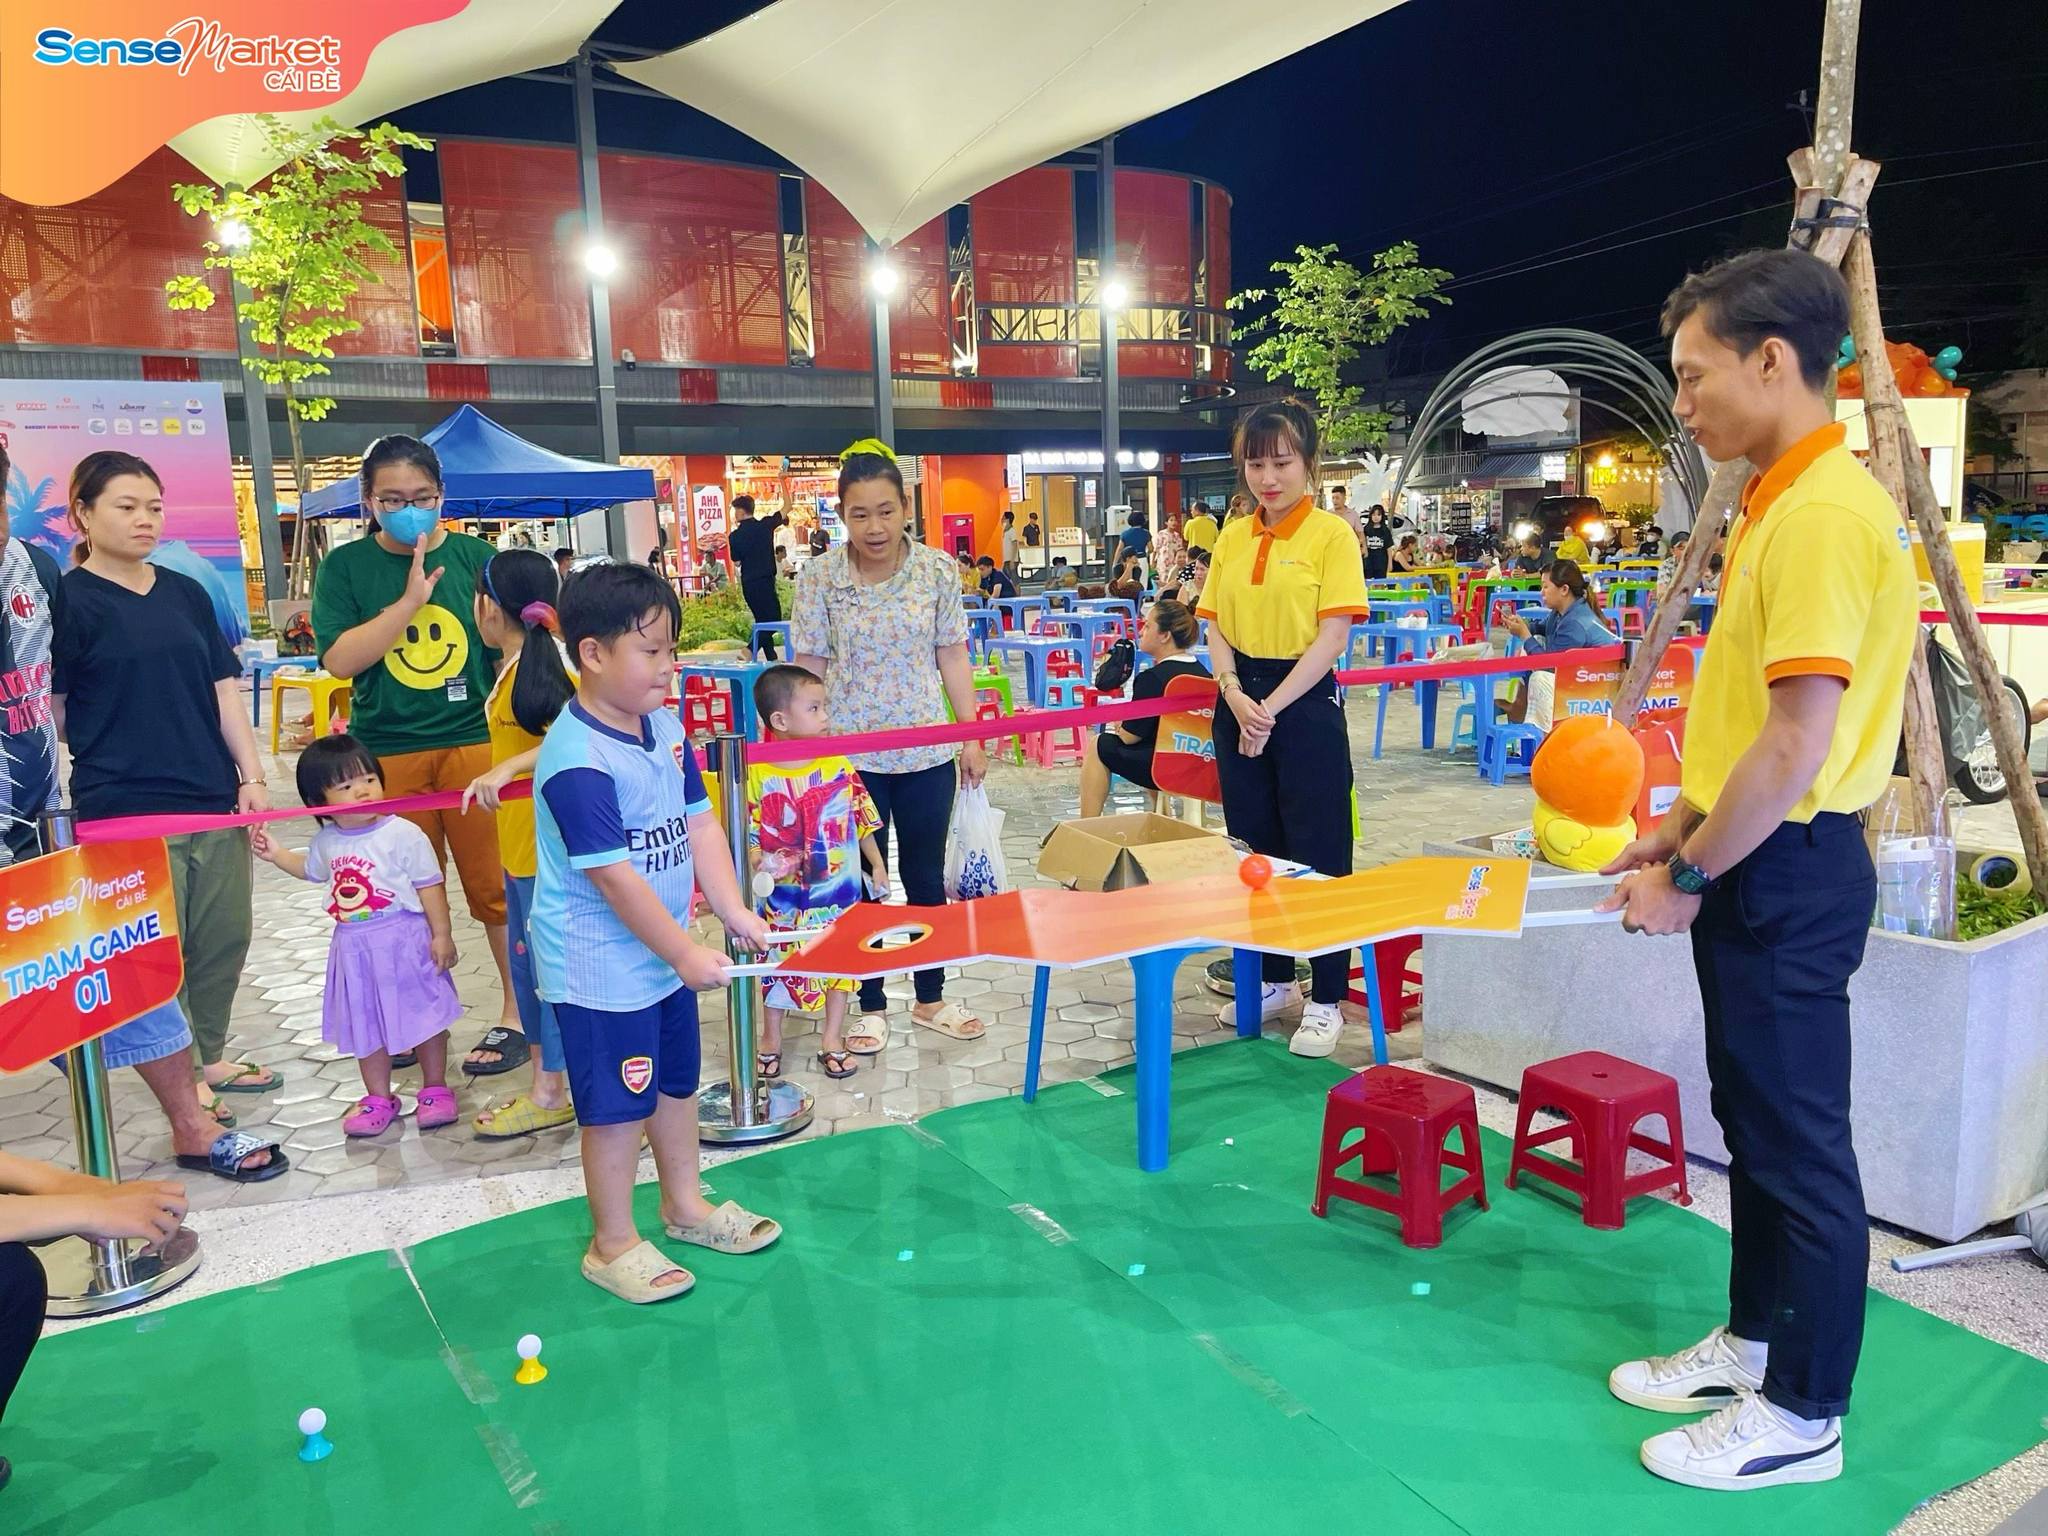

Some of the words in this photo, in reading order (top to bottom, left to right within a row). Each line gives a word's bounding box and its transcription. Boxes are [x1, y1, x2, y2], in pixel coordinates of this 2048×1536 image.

[698, 508, 723, 520] PIZZA
[701, 496, 719, 507] AHA
[1173, 732, 1217, 762] TRẠ
[646, 849, 669, 874] FLY
[116, 893, 132, 910] CÁI
[135, 888, 148, 904] BÈ
[3, 943, 84, 998] TRẠM
[89, 912, 162, 963] GAME
[75, 969, 111, 1014] 01
